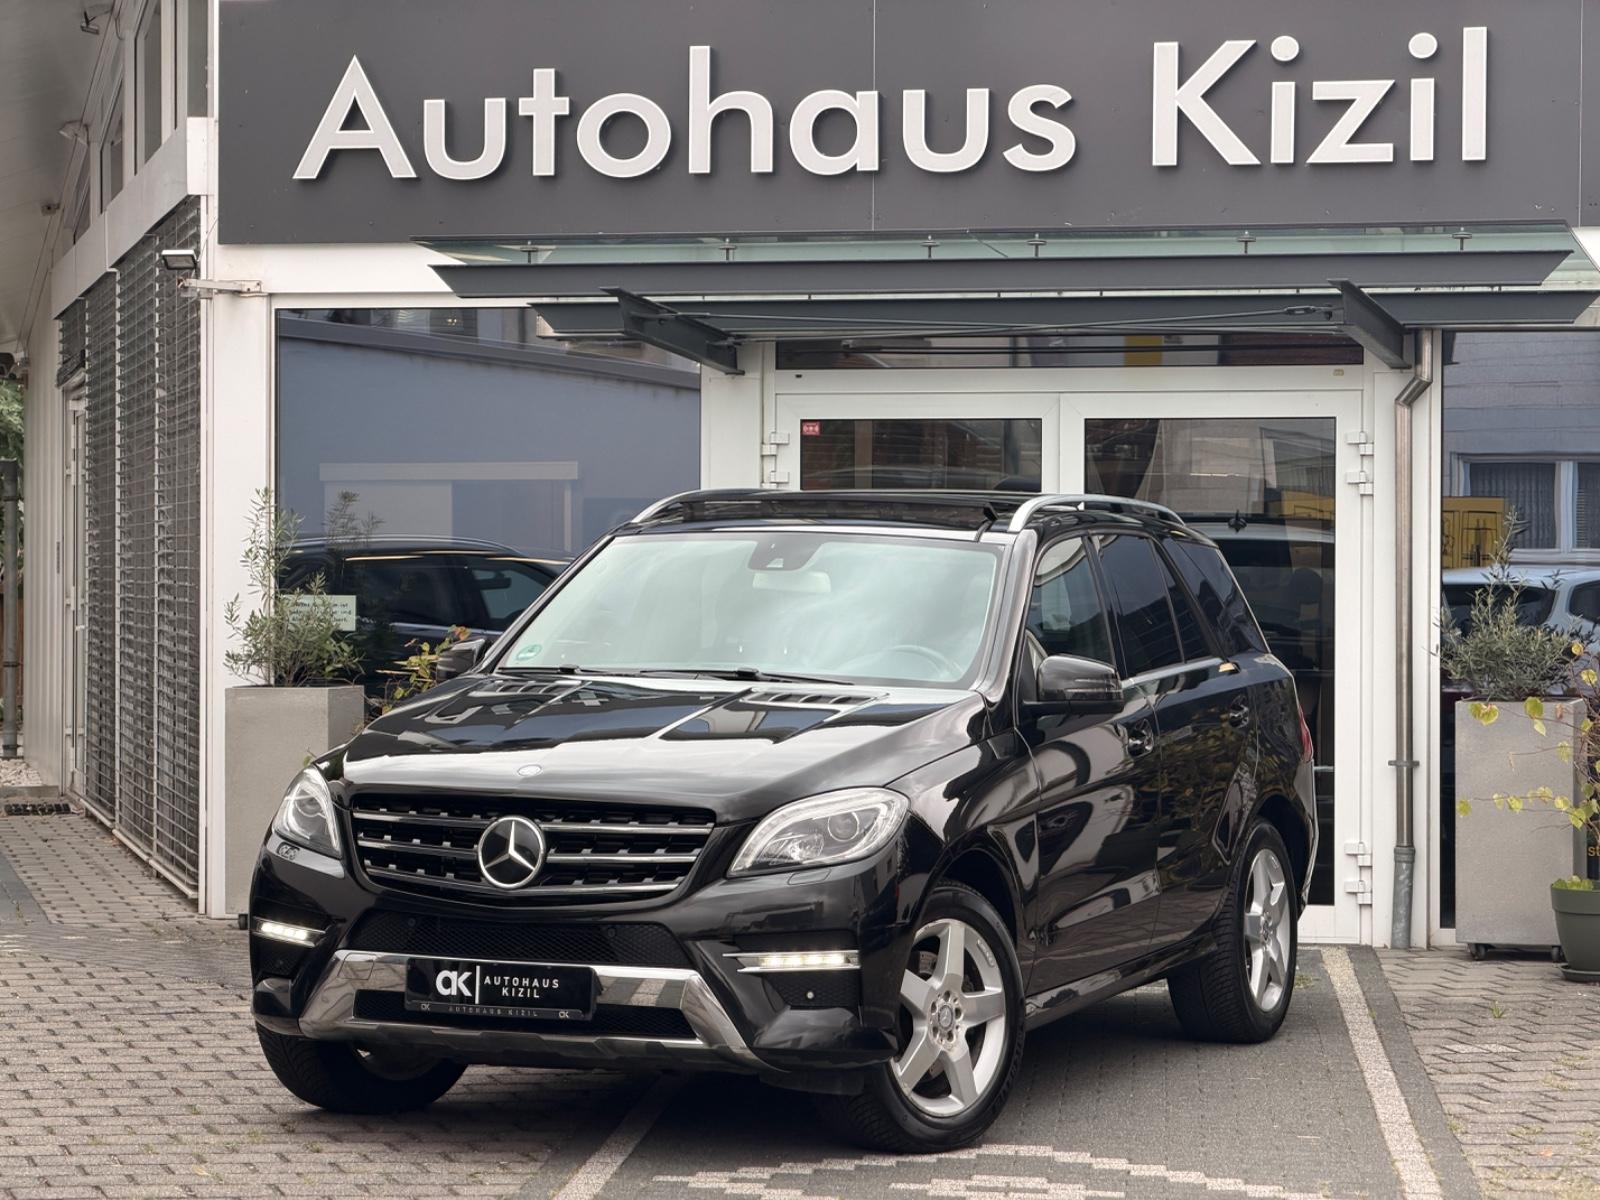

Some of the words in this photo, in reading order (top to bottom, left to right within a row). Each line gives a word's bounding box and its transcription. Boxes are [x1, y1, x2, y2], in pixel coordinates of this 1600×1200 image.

[292, 45, 1076, 181] Autohaus
[1151, 26, 1488, 167] Kizil
[483, 975, 560, 989] AUTOHAUS
[501, 987, 540, 999] KIZIL
[448, 1005, 502, 1016] AUTOHAUS
[508, 1008, 539, 1018] KIZIL
